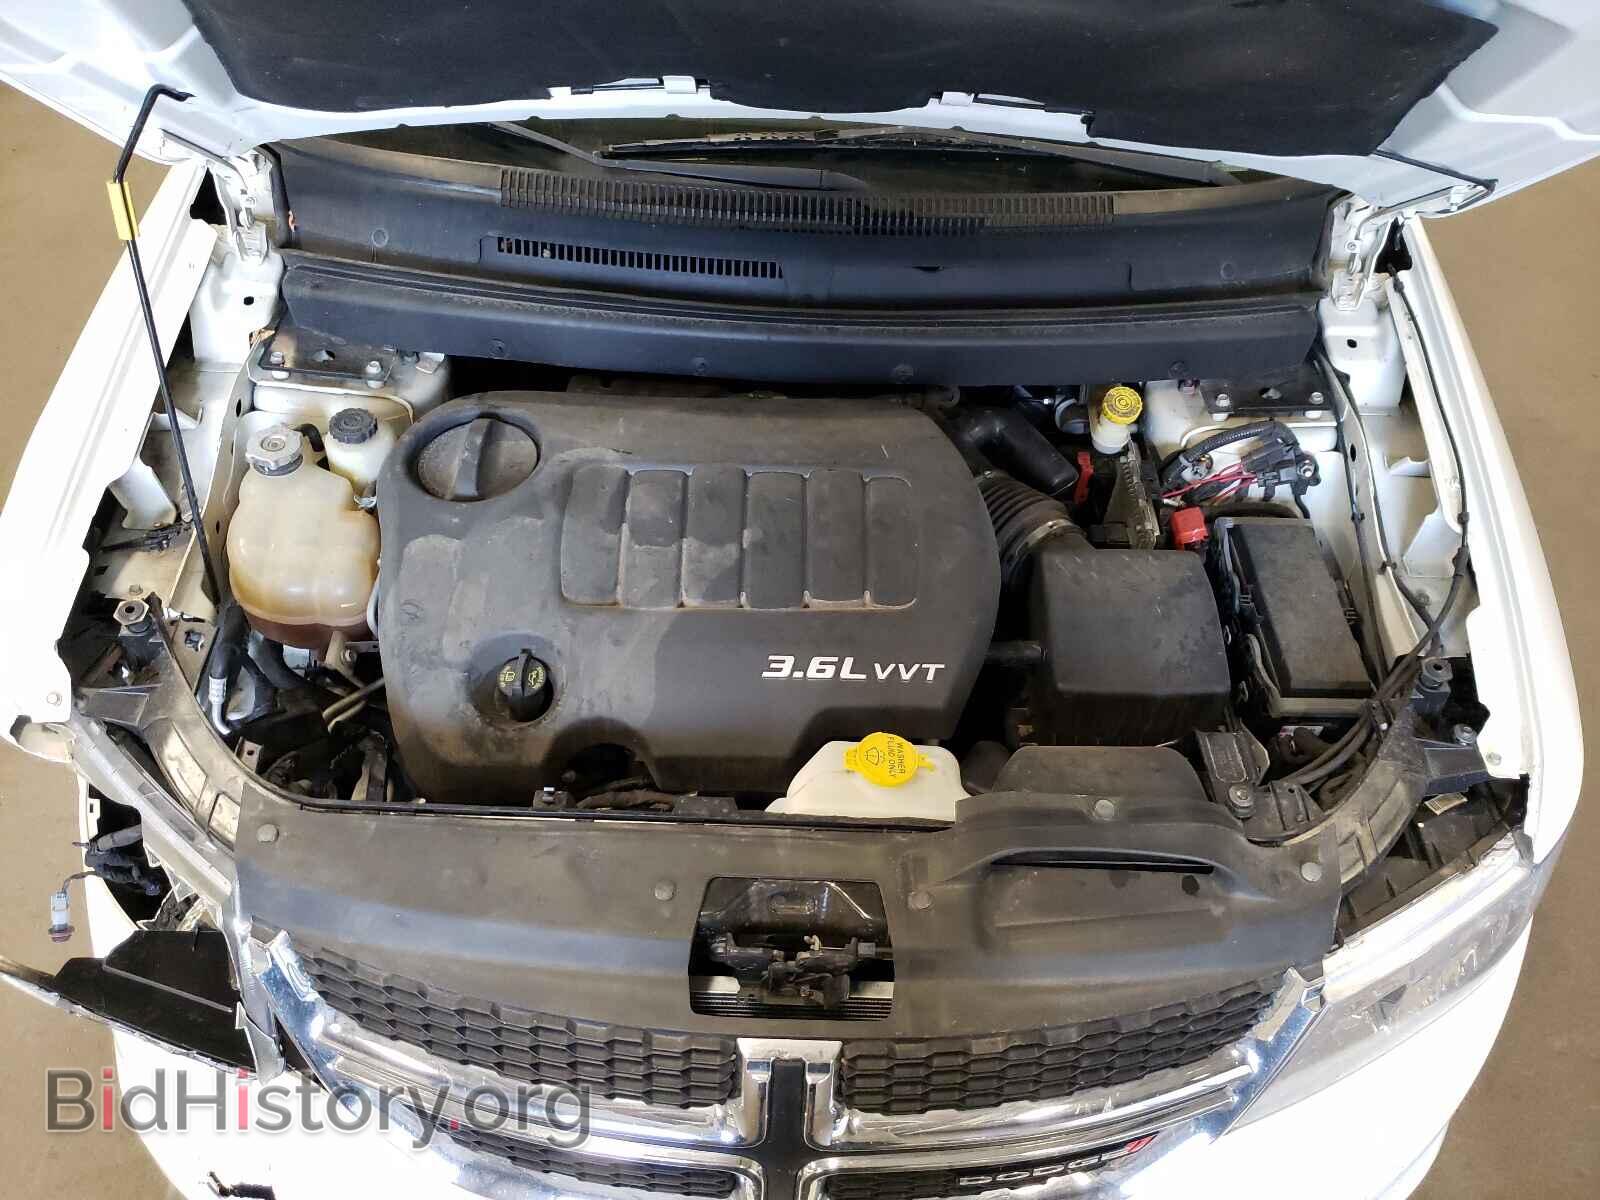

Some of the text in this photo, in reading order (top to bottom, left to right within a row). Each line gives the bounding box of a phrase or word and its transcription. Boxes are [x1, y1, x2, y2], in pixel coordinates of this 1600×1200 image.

[762, 655, 945, 682] 3.6L VVT
[888, 759, 897, 778] ONLY
[896, 741, 906, 775] WASHER
